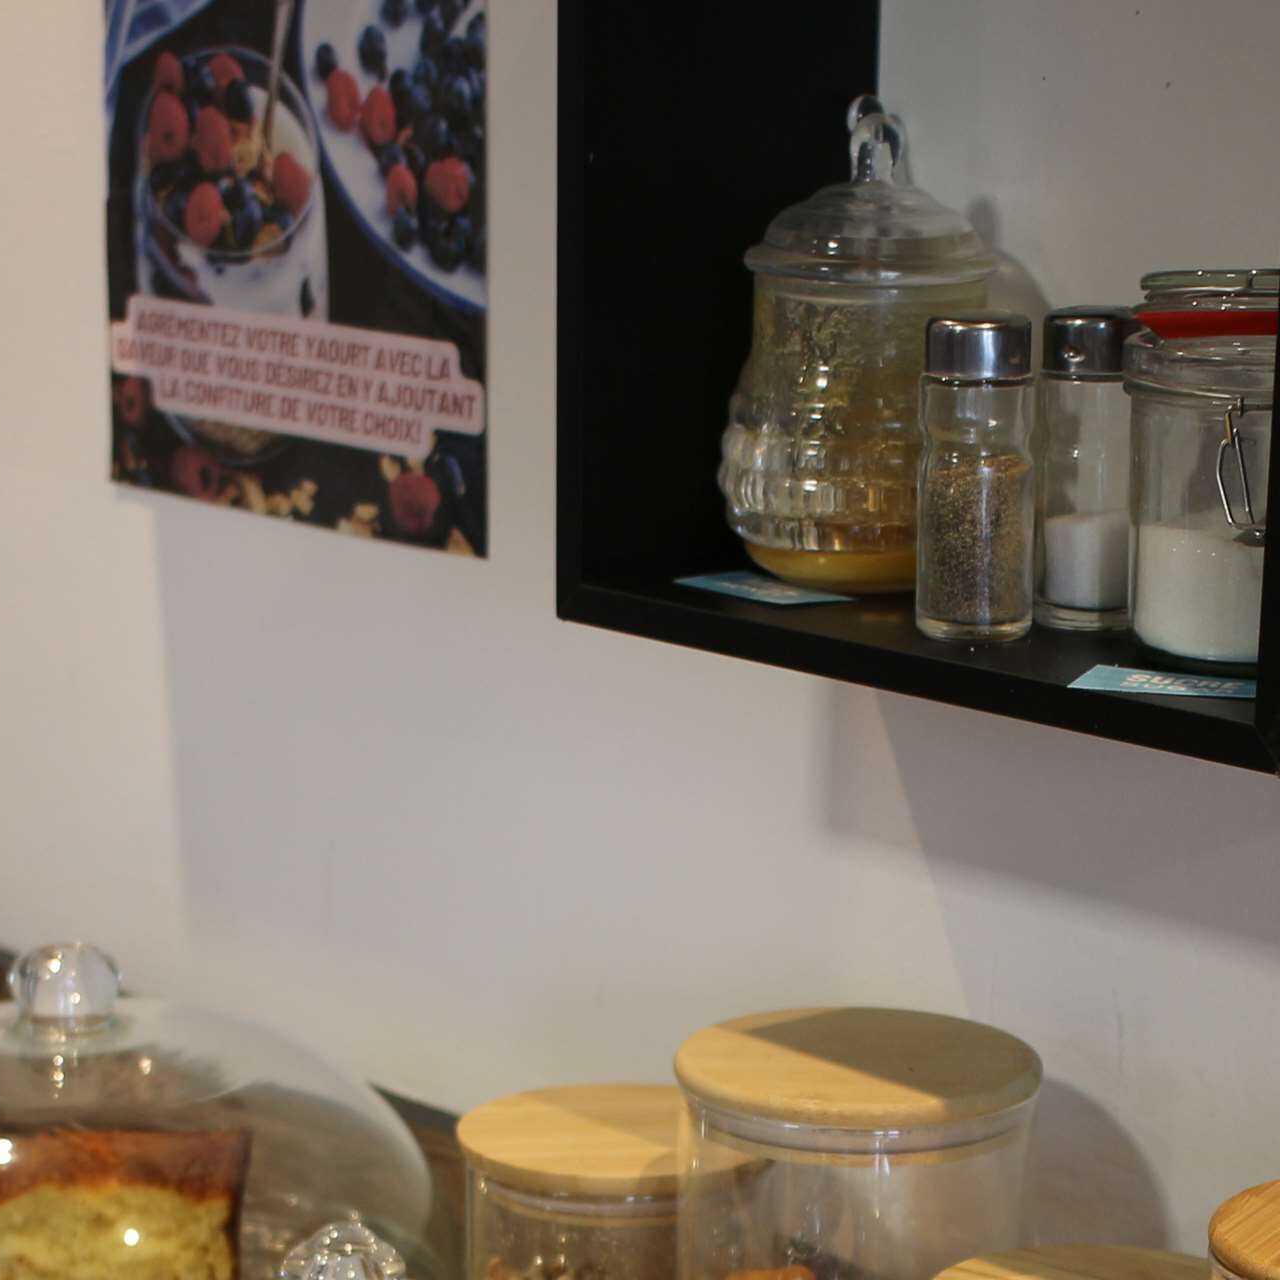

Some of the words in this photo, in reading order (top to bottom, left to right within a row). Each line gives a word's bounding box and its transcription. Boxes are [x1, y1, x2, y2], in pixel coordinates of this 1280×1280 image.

[180, 349, 210, 375] QUE
[217, 355, 258, 384] VOUS
[336, 372, 358, 399] EN
[361, 377, 375, 401] Y
[377, 380, 476, 421] AJOUTANT
[247, 326, 299, 359] VOTRE
[305, 335, 371, 369] YAOURT
[374, 348, 422, 378] AVEC
[425, 354, 452, 382] LA
[160, 374, 179, 399] LA
[184, 379, 273, 418] CONFITURE
[280, 394, 300, 422] DE
[306, 401, 360, 434] VOTRE
[364, 410, 422, 444] CHOIX!
